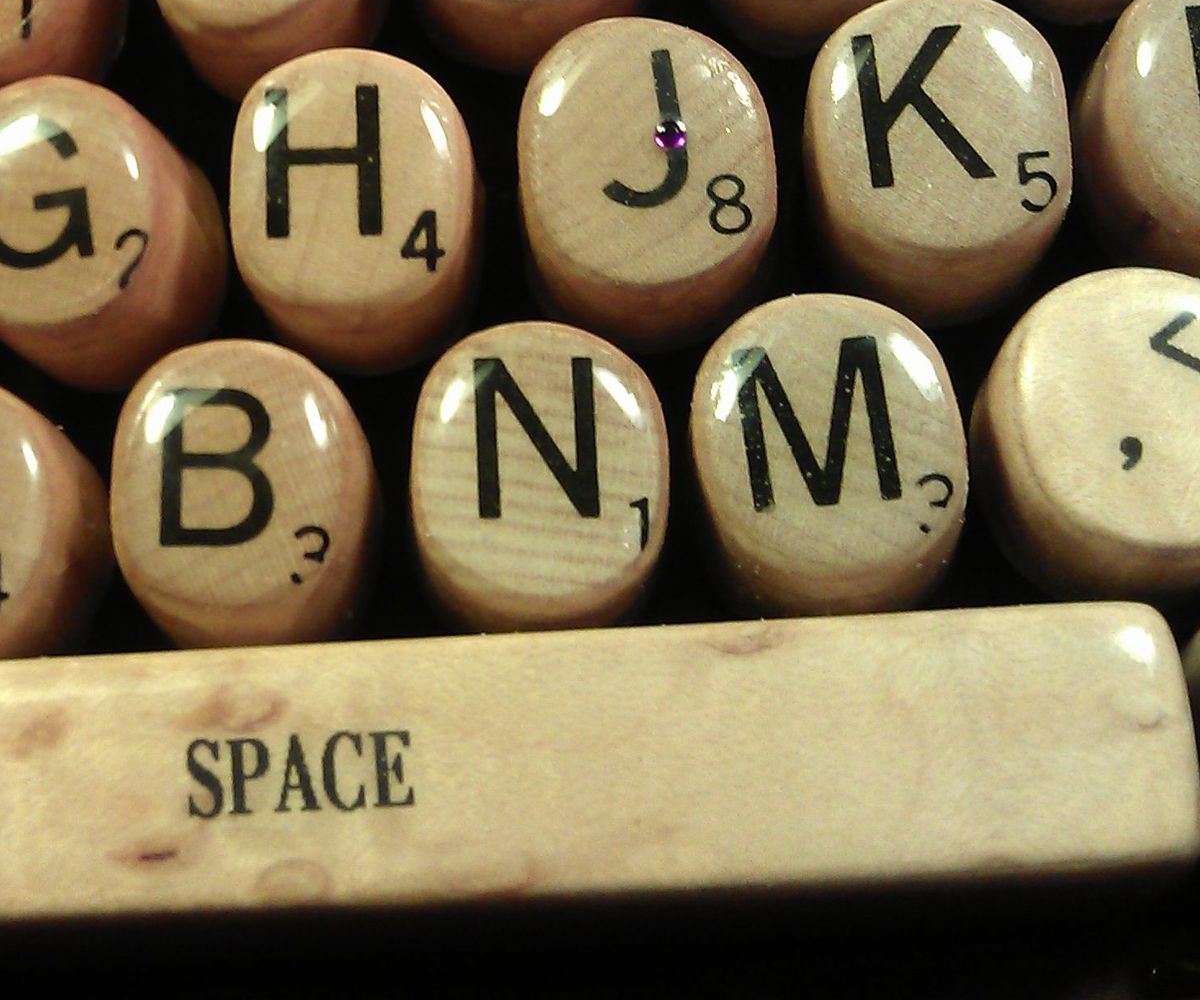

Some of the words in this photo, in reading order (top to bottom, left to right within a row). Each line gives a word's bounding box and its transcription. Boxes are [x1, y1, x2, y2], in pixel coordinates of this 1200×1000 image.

[265, 84, 382, 238] H
[401, 210, 446, 272] 4
[603, 49, 688, 208] J
[706, 173, 753, 235] 8
[851, 24, 997, 188] K
[1017, 151, 1058, 213] 5
[160, 388, 274, 547] B
[473, 356, 601, 520] N
[629, 497, 649, 552] 1
[730, 335, 902, 514] M
[185, 729, 416, 819] SPACE
